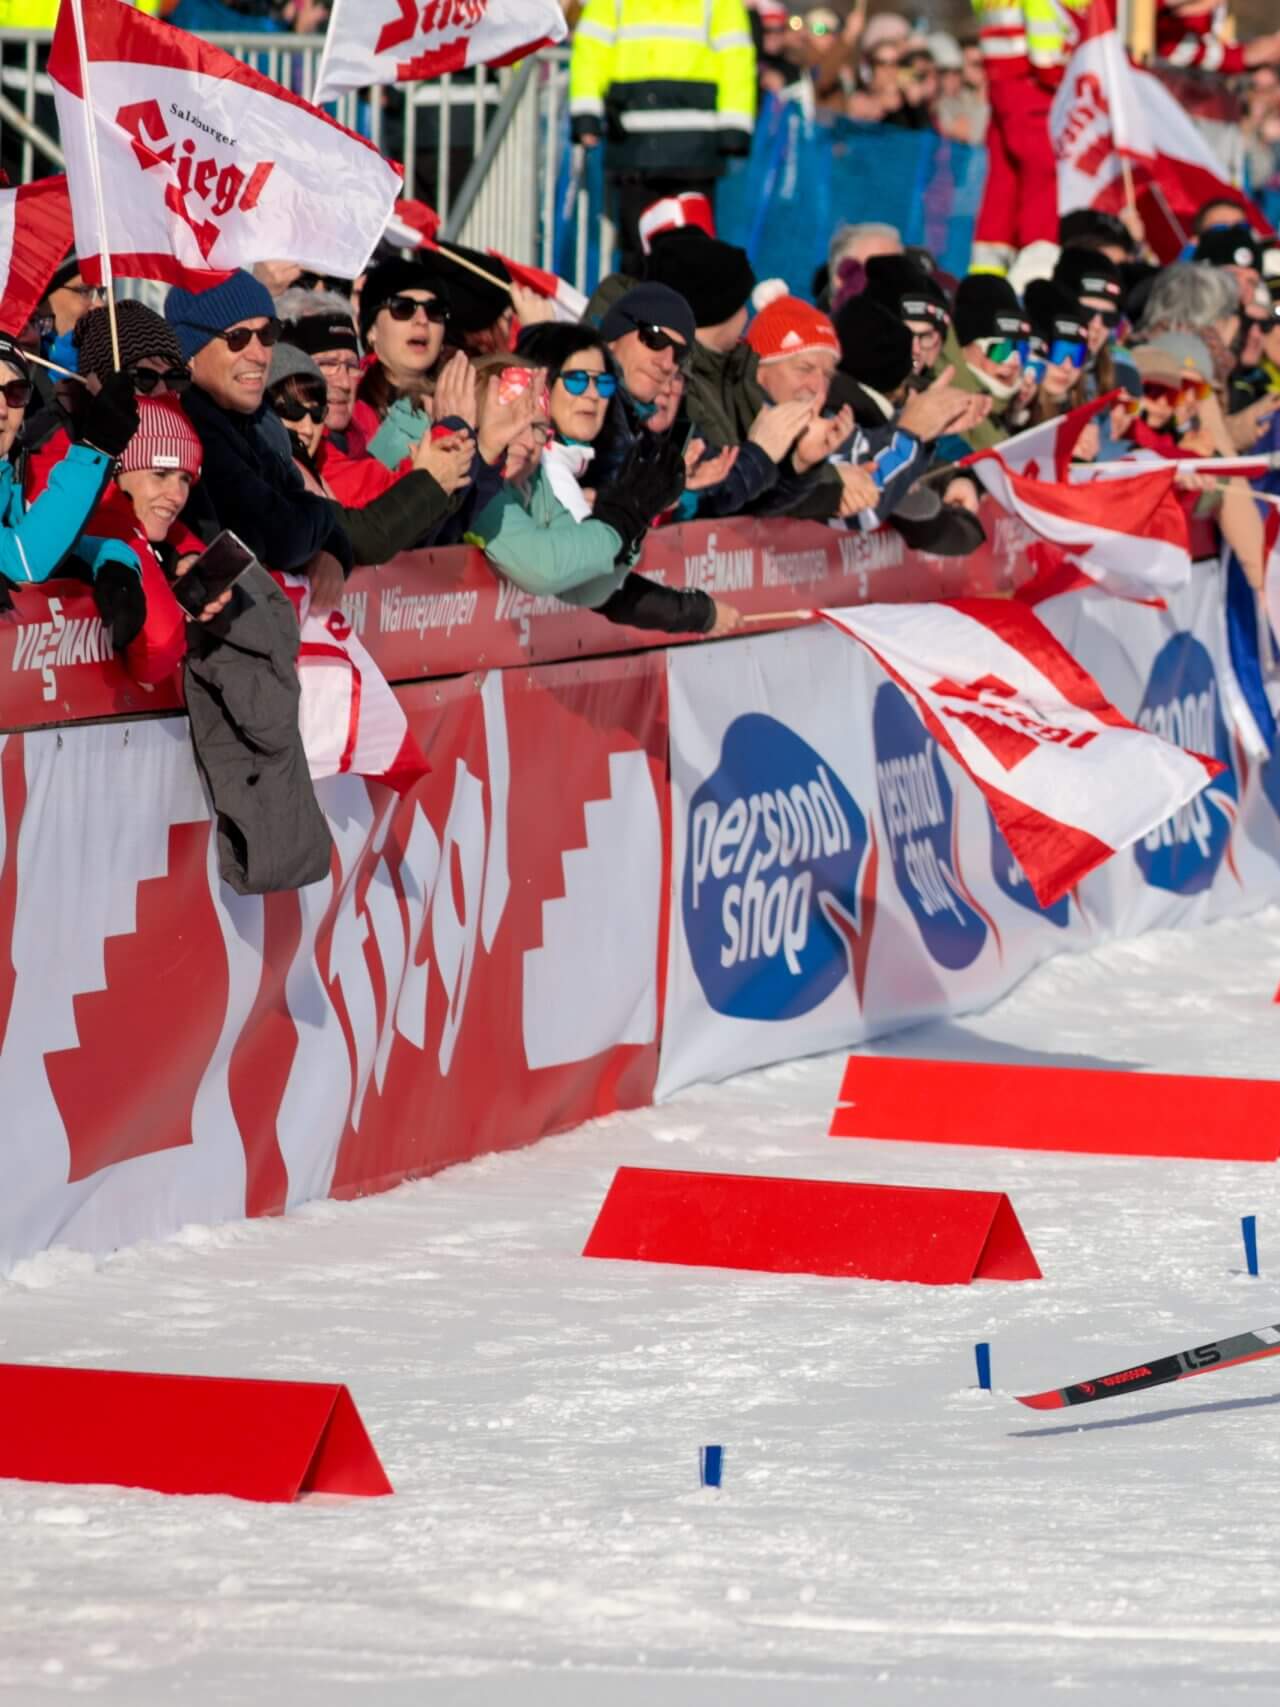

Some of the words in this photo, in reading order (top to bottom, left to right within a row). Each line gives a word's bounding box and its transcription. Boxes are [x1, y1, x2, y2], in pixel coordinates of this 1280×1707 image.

[115, 98, 276, 217] Siegl
[379, 583, 478, 640] Wärmepumpen
[693, 764, 851, 910] personal
[720, 849, 813, 975] shop
